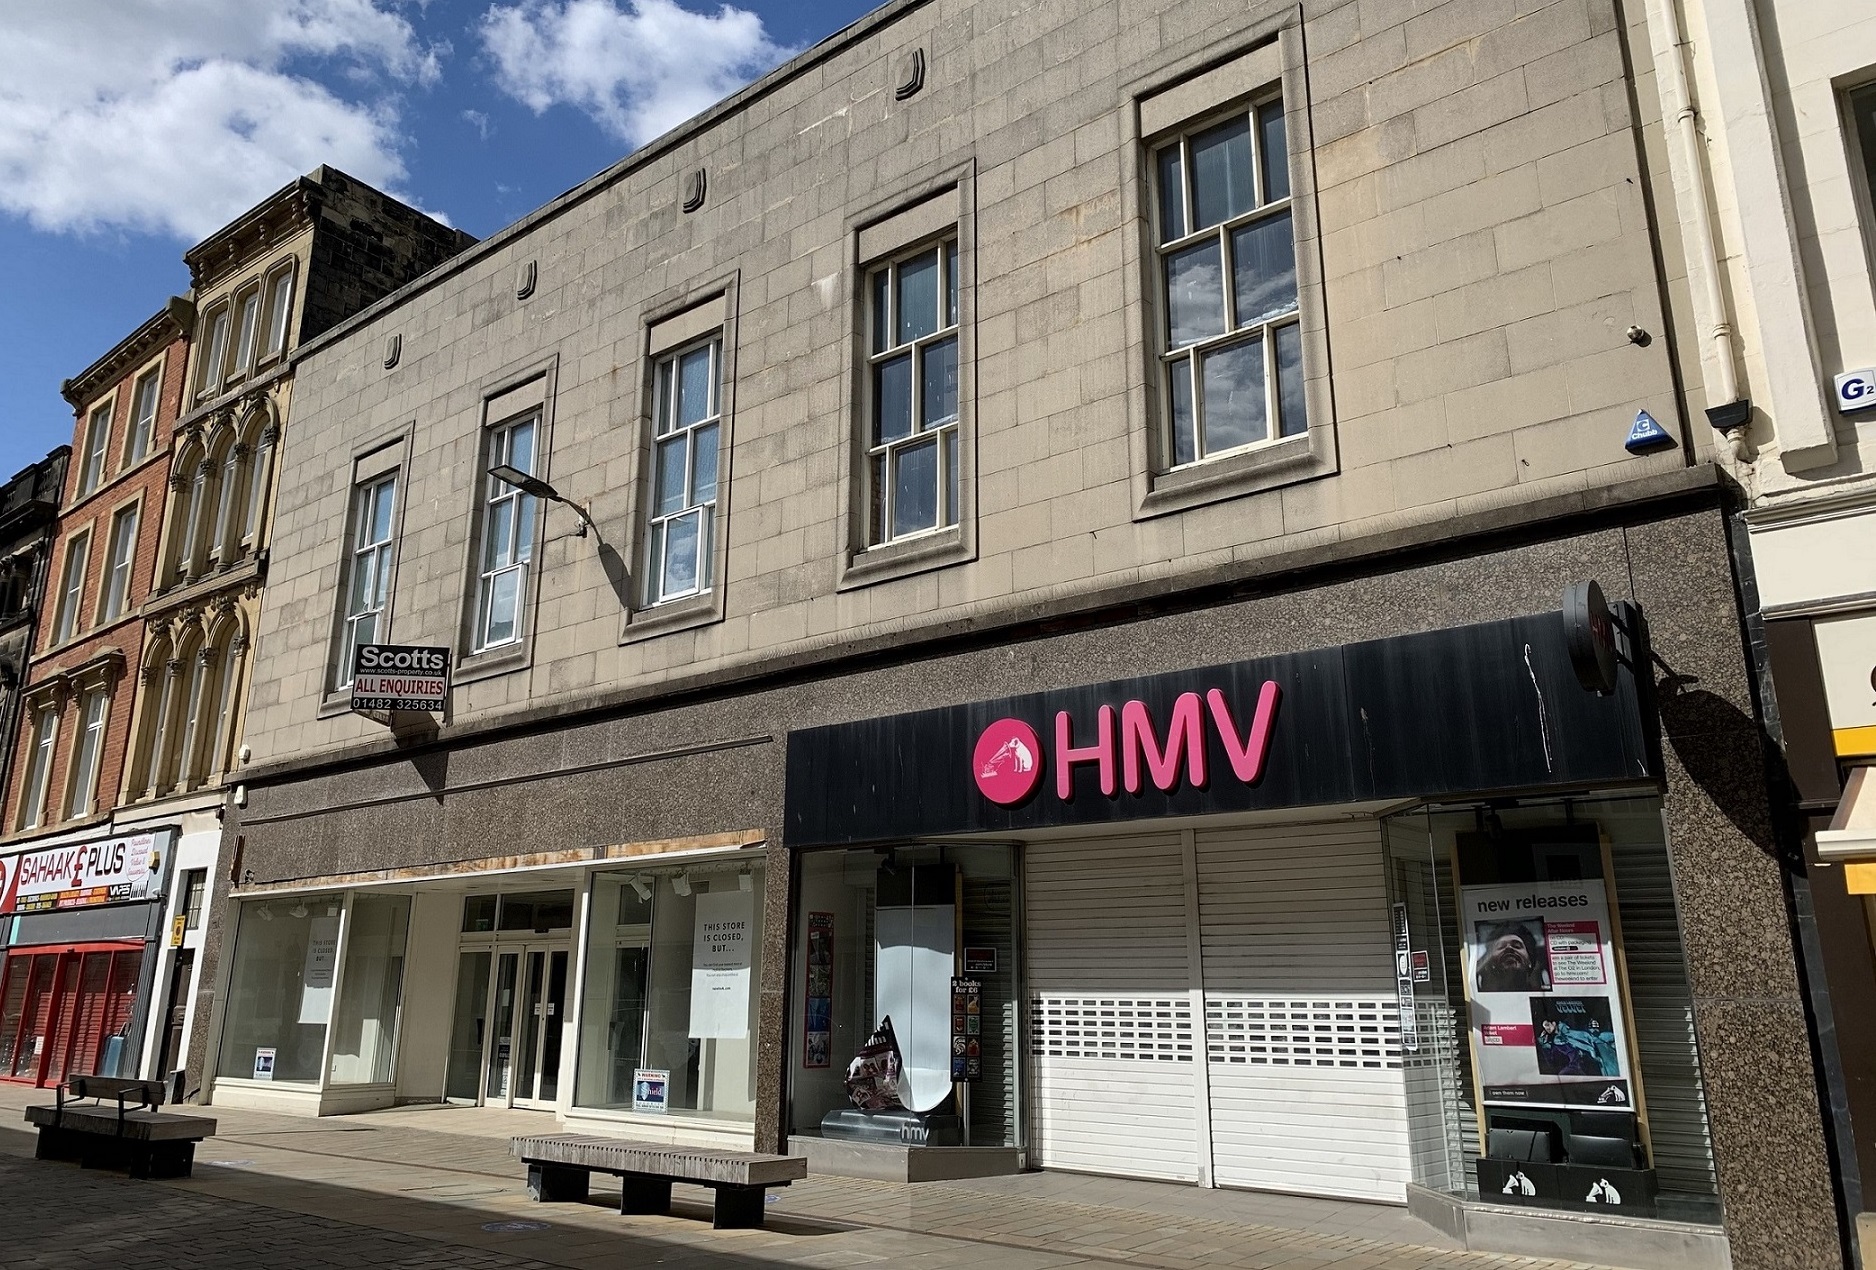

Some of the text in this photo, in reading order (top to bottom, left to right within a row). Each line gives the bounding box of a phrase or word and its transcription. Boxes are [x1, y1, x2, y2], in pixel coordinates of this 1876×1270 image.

[1631, 429, 1658, 440] Chubb
[360, 646, 444, 669] Scotts
[360, 668, 442, 676] www.scotts-property.co.uk
[355, 678, 443, 697] ALL ENQUIRIES
[353, 698, 443, 710] 01482 325634
[1055, 680, 1280, 800] HMV
[20, 850, 75, 886] SAHAAK
[86, 842, 126, 878] PLUS
[1477, 894, 1589, 913] new releases
[703, 921, 745, 932] THIS STORE
[703, 932, 744, 942] IS CLOSED,
[901, 1122, 930, 1141] hmv
